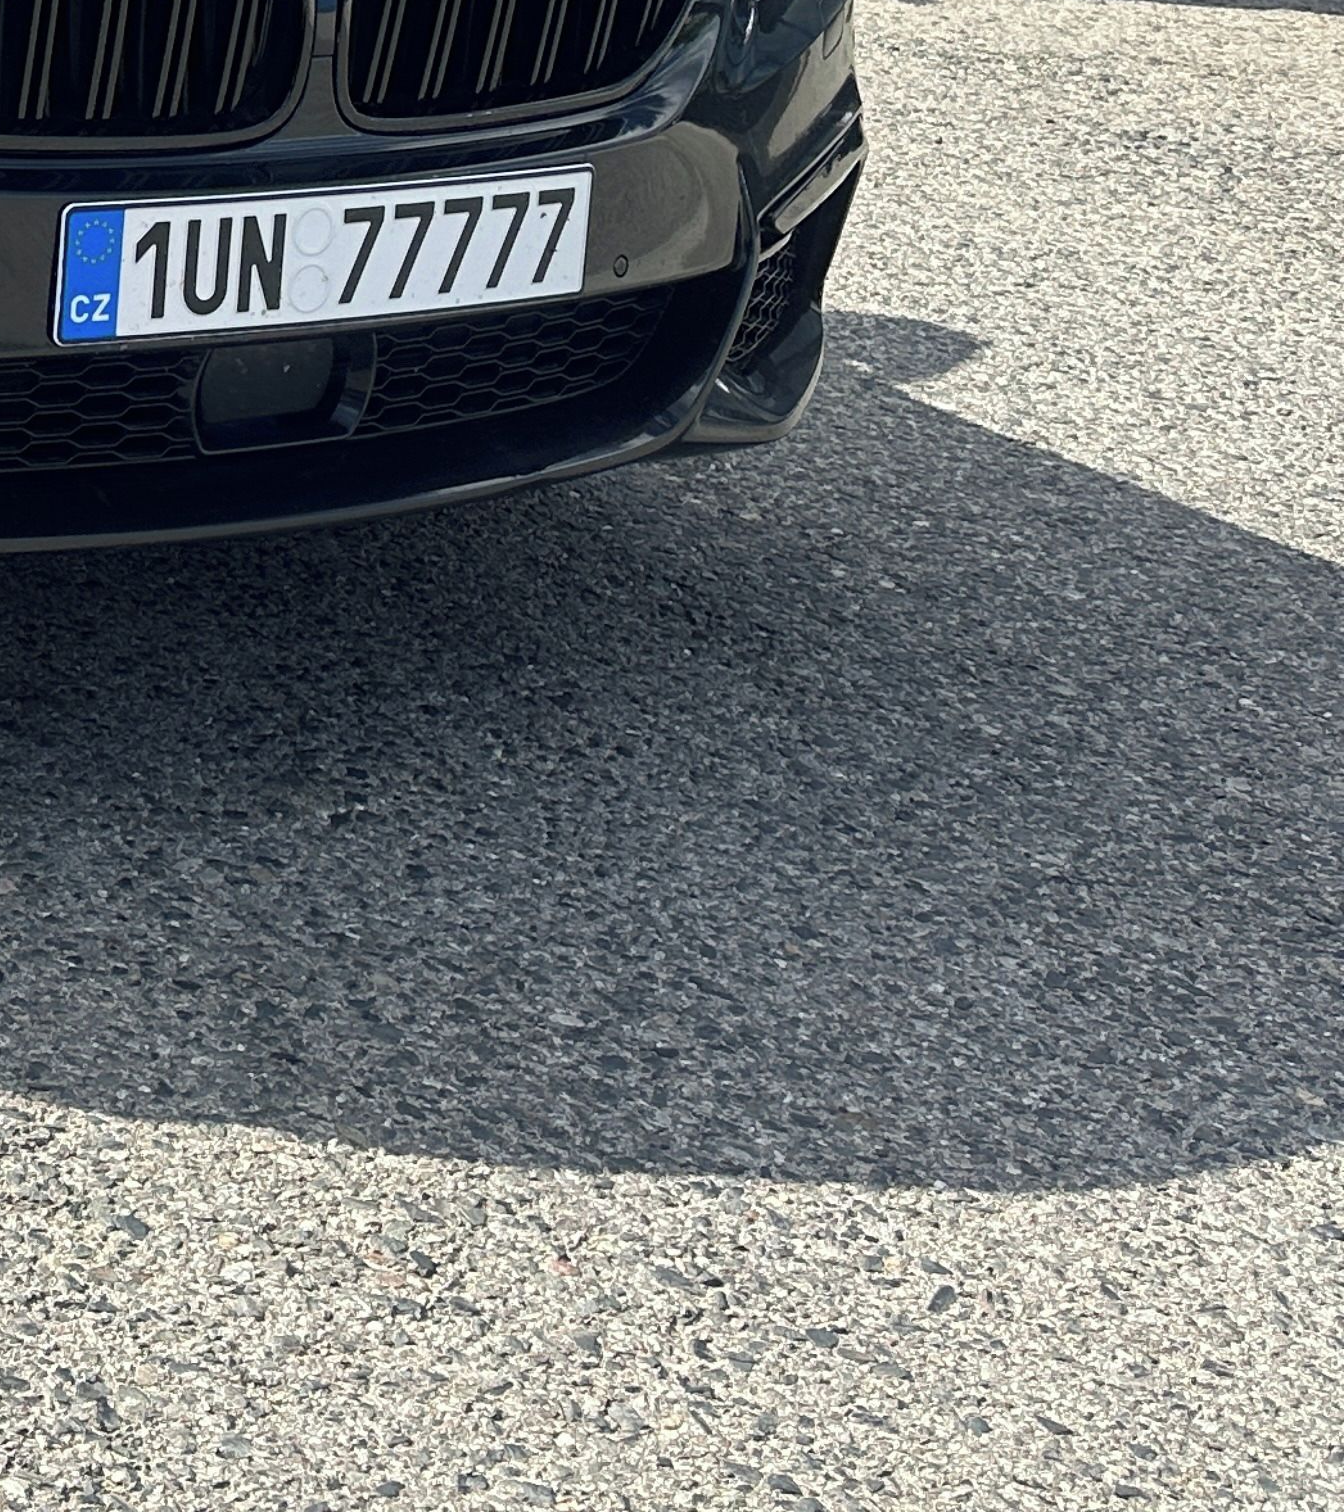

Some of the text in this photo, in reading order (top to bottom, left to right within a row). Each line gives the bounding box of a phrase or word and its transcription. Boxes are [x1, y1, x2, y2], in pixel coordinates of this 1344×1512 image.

[69, 187, 577, 324] CZ 1UN 77777
